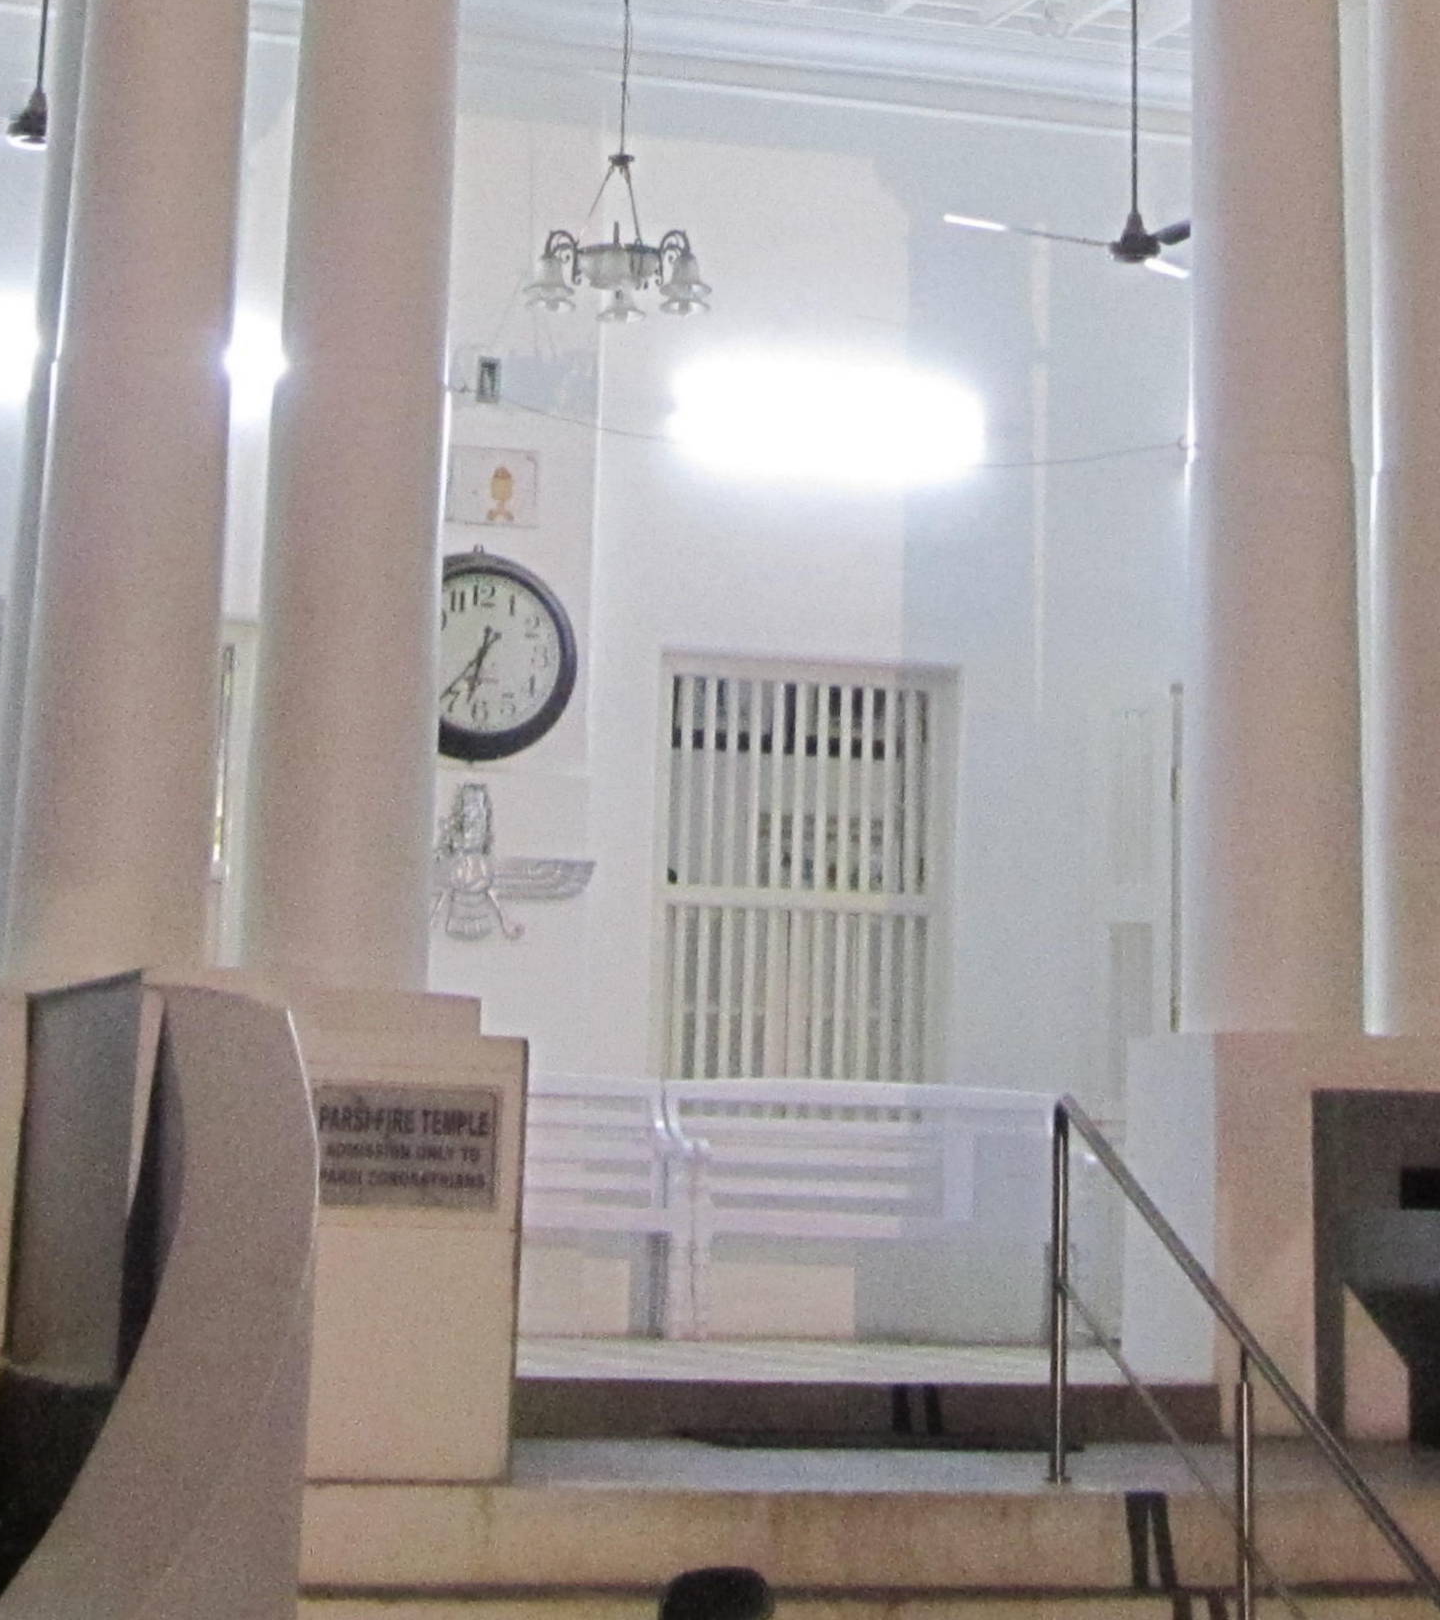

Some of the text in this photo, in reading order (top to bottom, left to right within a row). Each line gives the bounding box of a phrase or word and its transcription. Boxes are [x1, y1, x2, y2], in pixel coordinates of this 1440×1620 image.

[450, 590, 465, 613] 11
[473, 585, 496, 608] 12
[422, 1109, 490, 1136] TEMPLE
